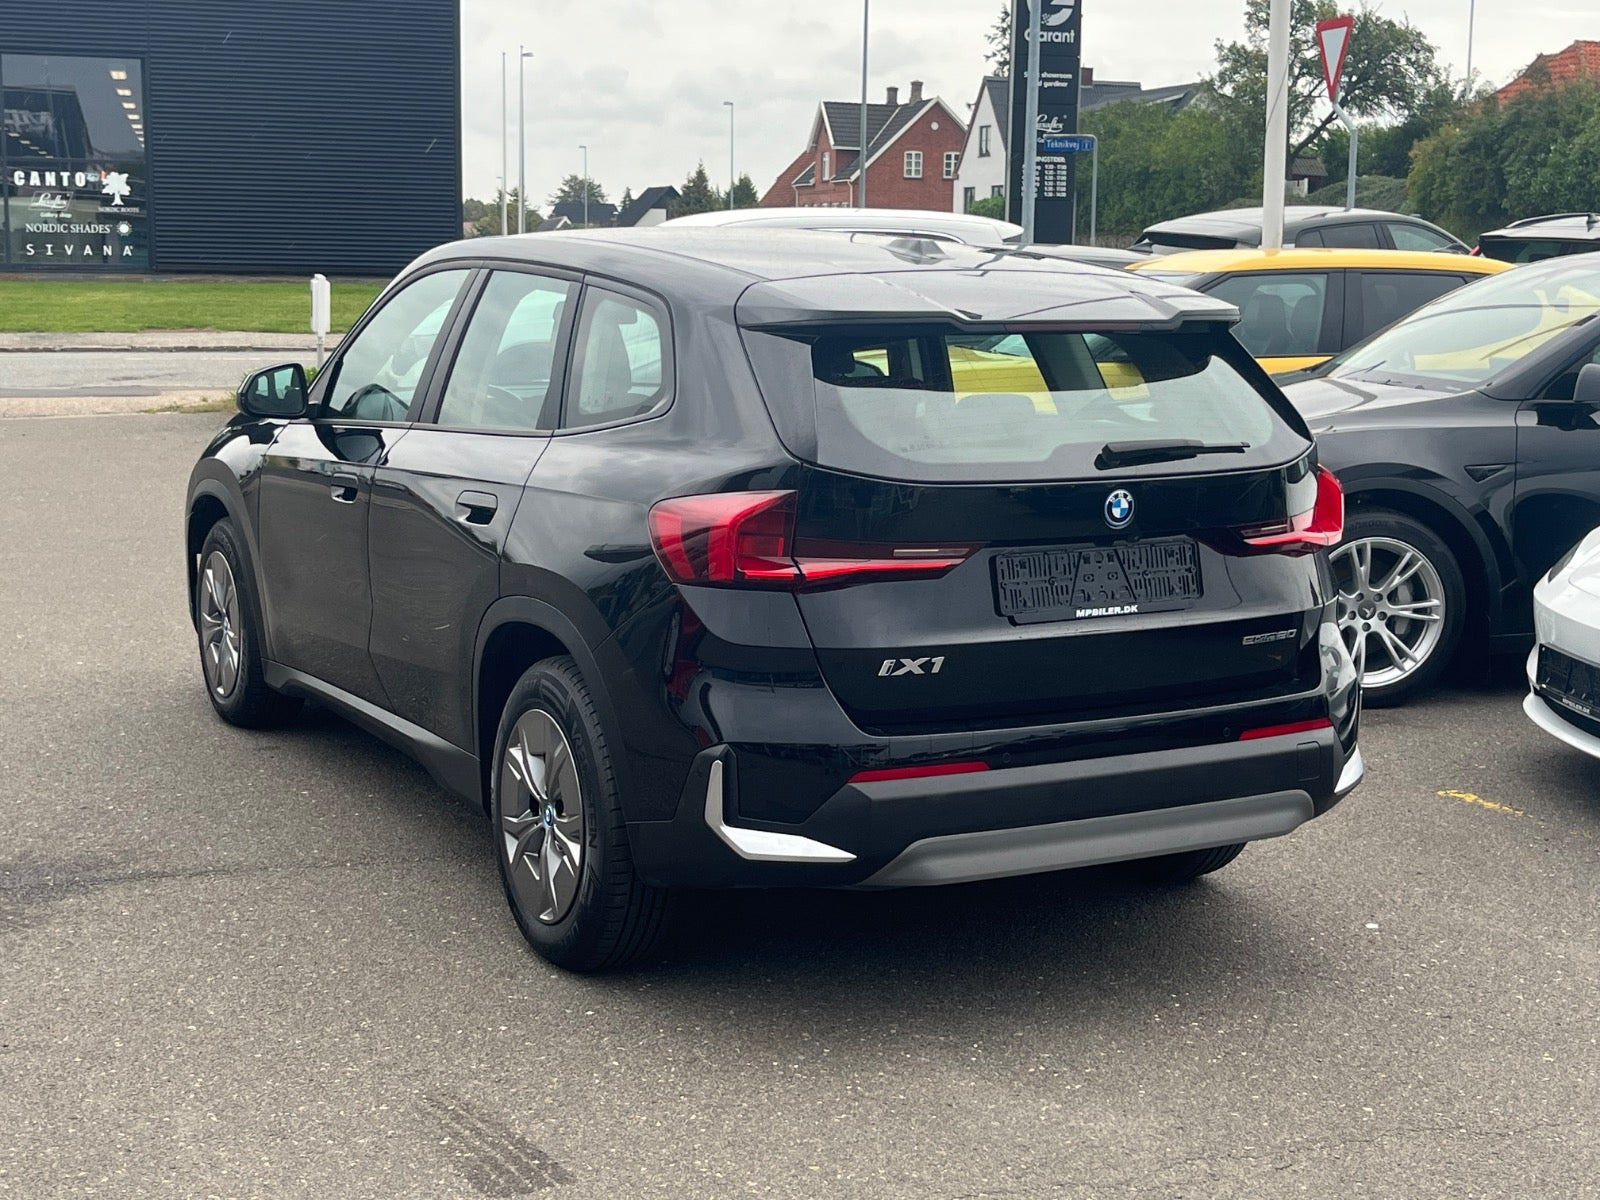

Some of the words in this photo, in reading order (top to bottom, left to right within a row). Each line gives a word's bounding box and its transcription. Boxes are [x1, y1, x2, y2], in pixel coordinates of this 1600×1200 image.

[1046, 140, 1080, 151] Teknikvej
[13, 170, 87, 187] CANTO
[25, 223, 69, 234] NORDIC
[70, 224, 111, 234] SHADES
[26, 243, 132, 256] SIVANA
[1075, 604, 1139, 618] MPBILER.DK
[877, 656, 945, 677] iX1
